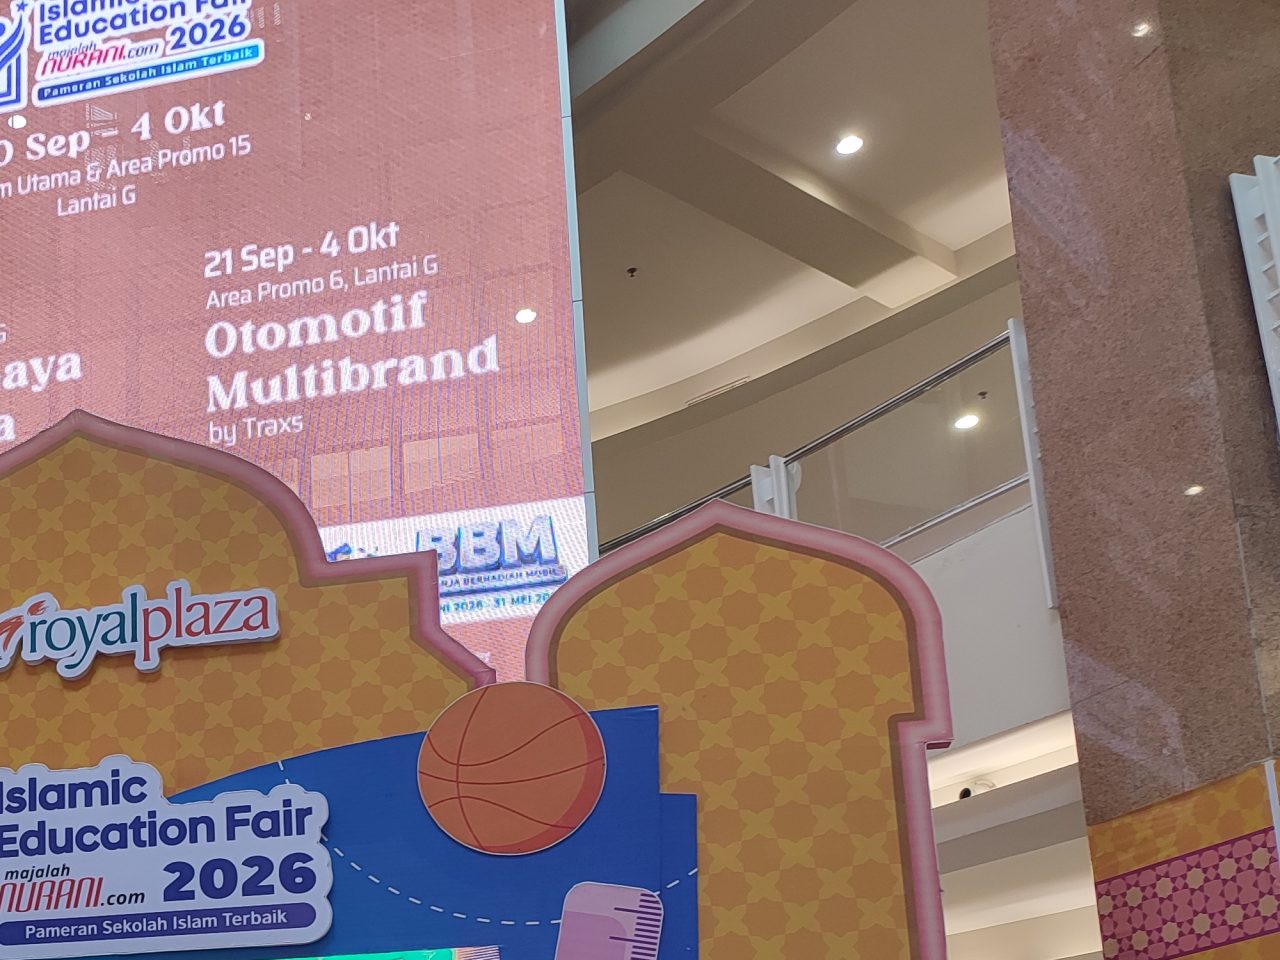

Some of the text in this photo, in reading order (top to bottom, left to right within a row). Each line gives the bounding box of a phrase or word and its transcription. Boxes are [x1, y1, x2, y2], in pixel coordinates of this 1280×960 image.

[39, 1, 187, 45] Education
[170, 15, 247, 51] 2026
[43, 48, 254, 98] Pameran Sekolah Islam Terbaik
[48, 41, 97, 59] majalah
[26, 130, 91, 160] Sep
[131, 112, 152, 141] 4
[164, 100, 225, 134] Okt
[17, 169, 81, 194] Utama
[86, 162, 101, 183] &
[106, 151, 152, 179] Area
[158, 143, 225, 170] Promo
[229, 134, 251, 157] 15
[57, 184, 136, 217] Lantai G
[204, 248, 232, 278] 21
[240, 243, 294, 273] Sep
[320, 230, 340, 257] 4
[348, 221, 400, 255] Okt
[205, 254, 438, 310] Area Promo 6, Lantai G
[204, 290, 428, 359] Otomotif
[206, 334, 500, 413] Multibrand
[208, 415, 304, 446] by Traxs
[29, 587, 271, 669] royalplaza
[226, 799, 313, 841] Fair
[4, 864, 71, 883] majalah
[162, 852, 317, 902] 2026
[25, 909, 288, 939] Pameran Sekolah Islam Terbaik
